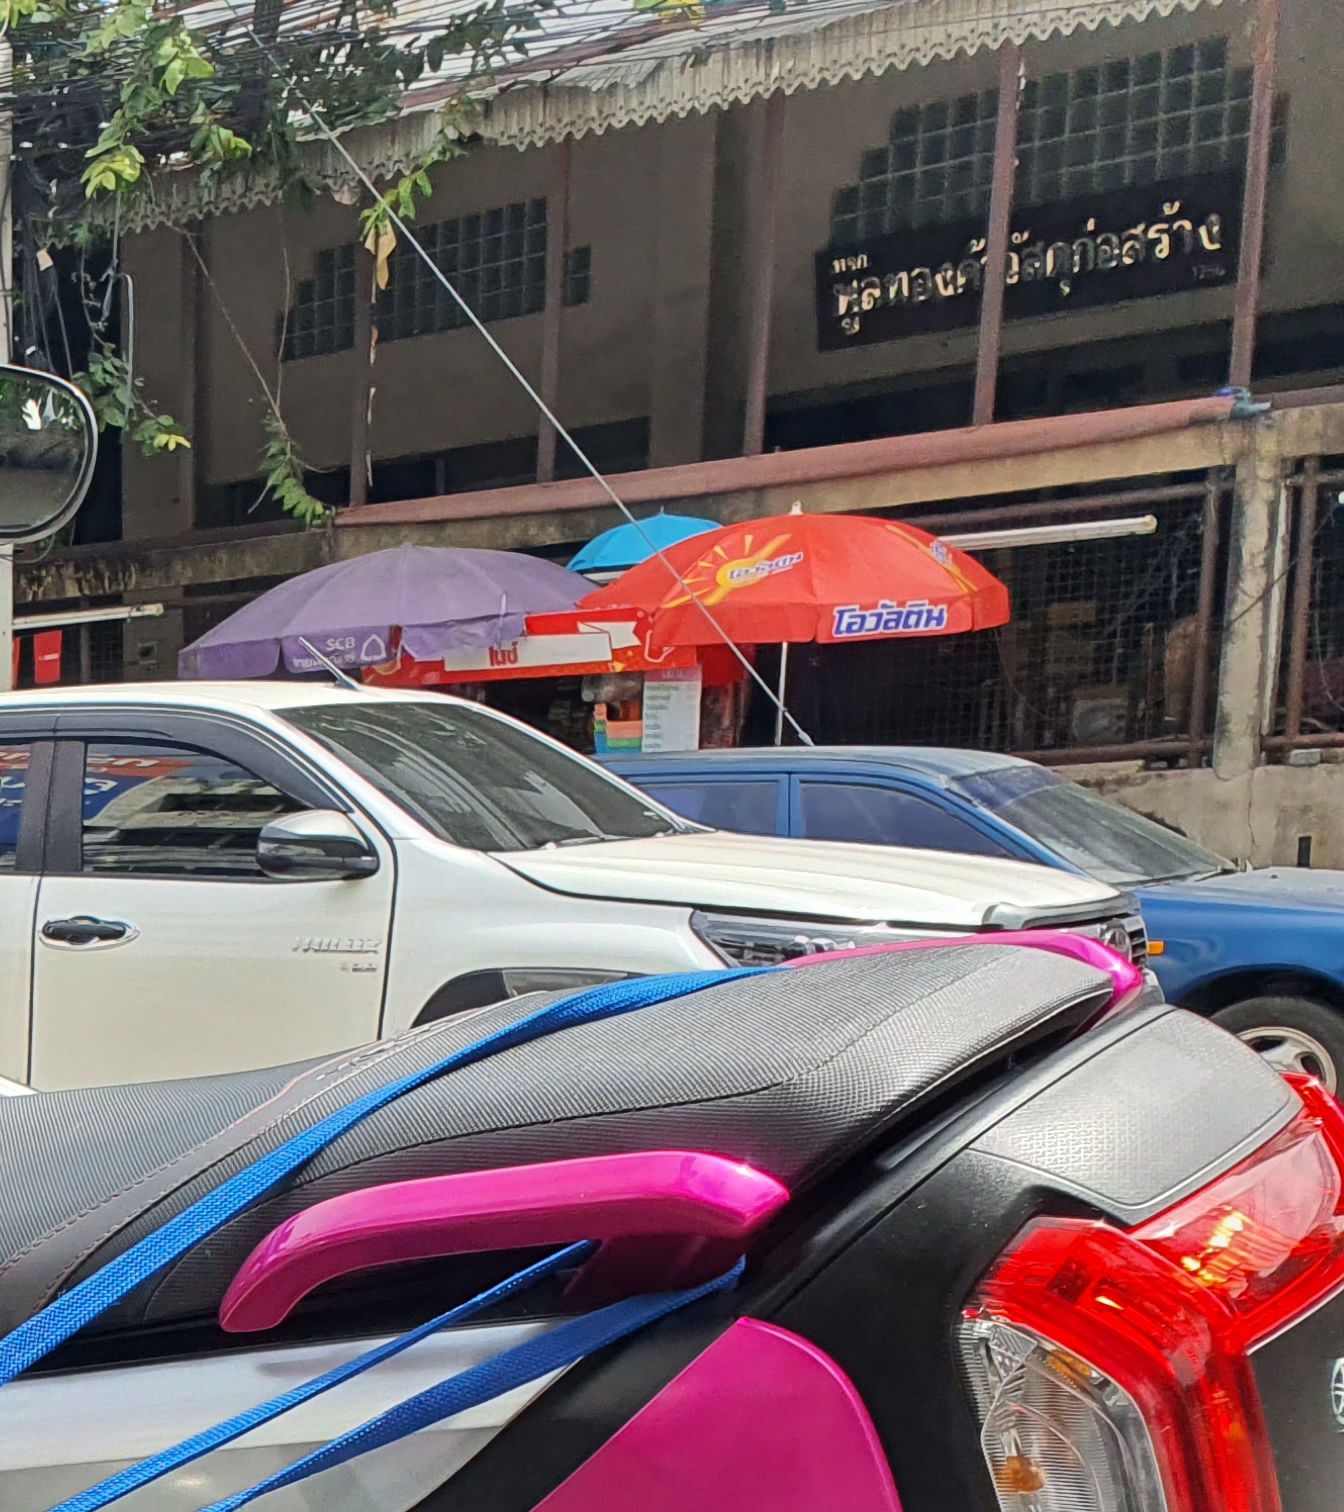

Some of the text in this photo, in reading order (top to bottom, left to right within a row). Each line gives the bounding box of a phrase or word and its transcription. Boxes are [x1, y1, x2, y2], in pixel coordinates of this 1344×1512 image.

[832, 600, 949, 638] โอวัลติน
[326, 636, 356, 652] SCB
